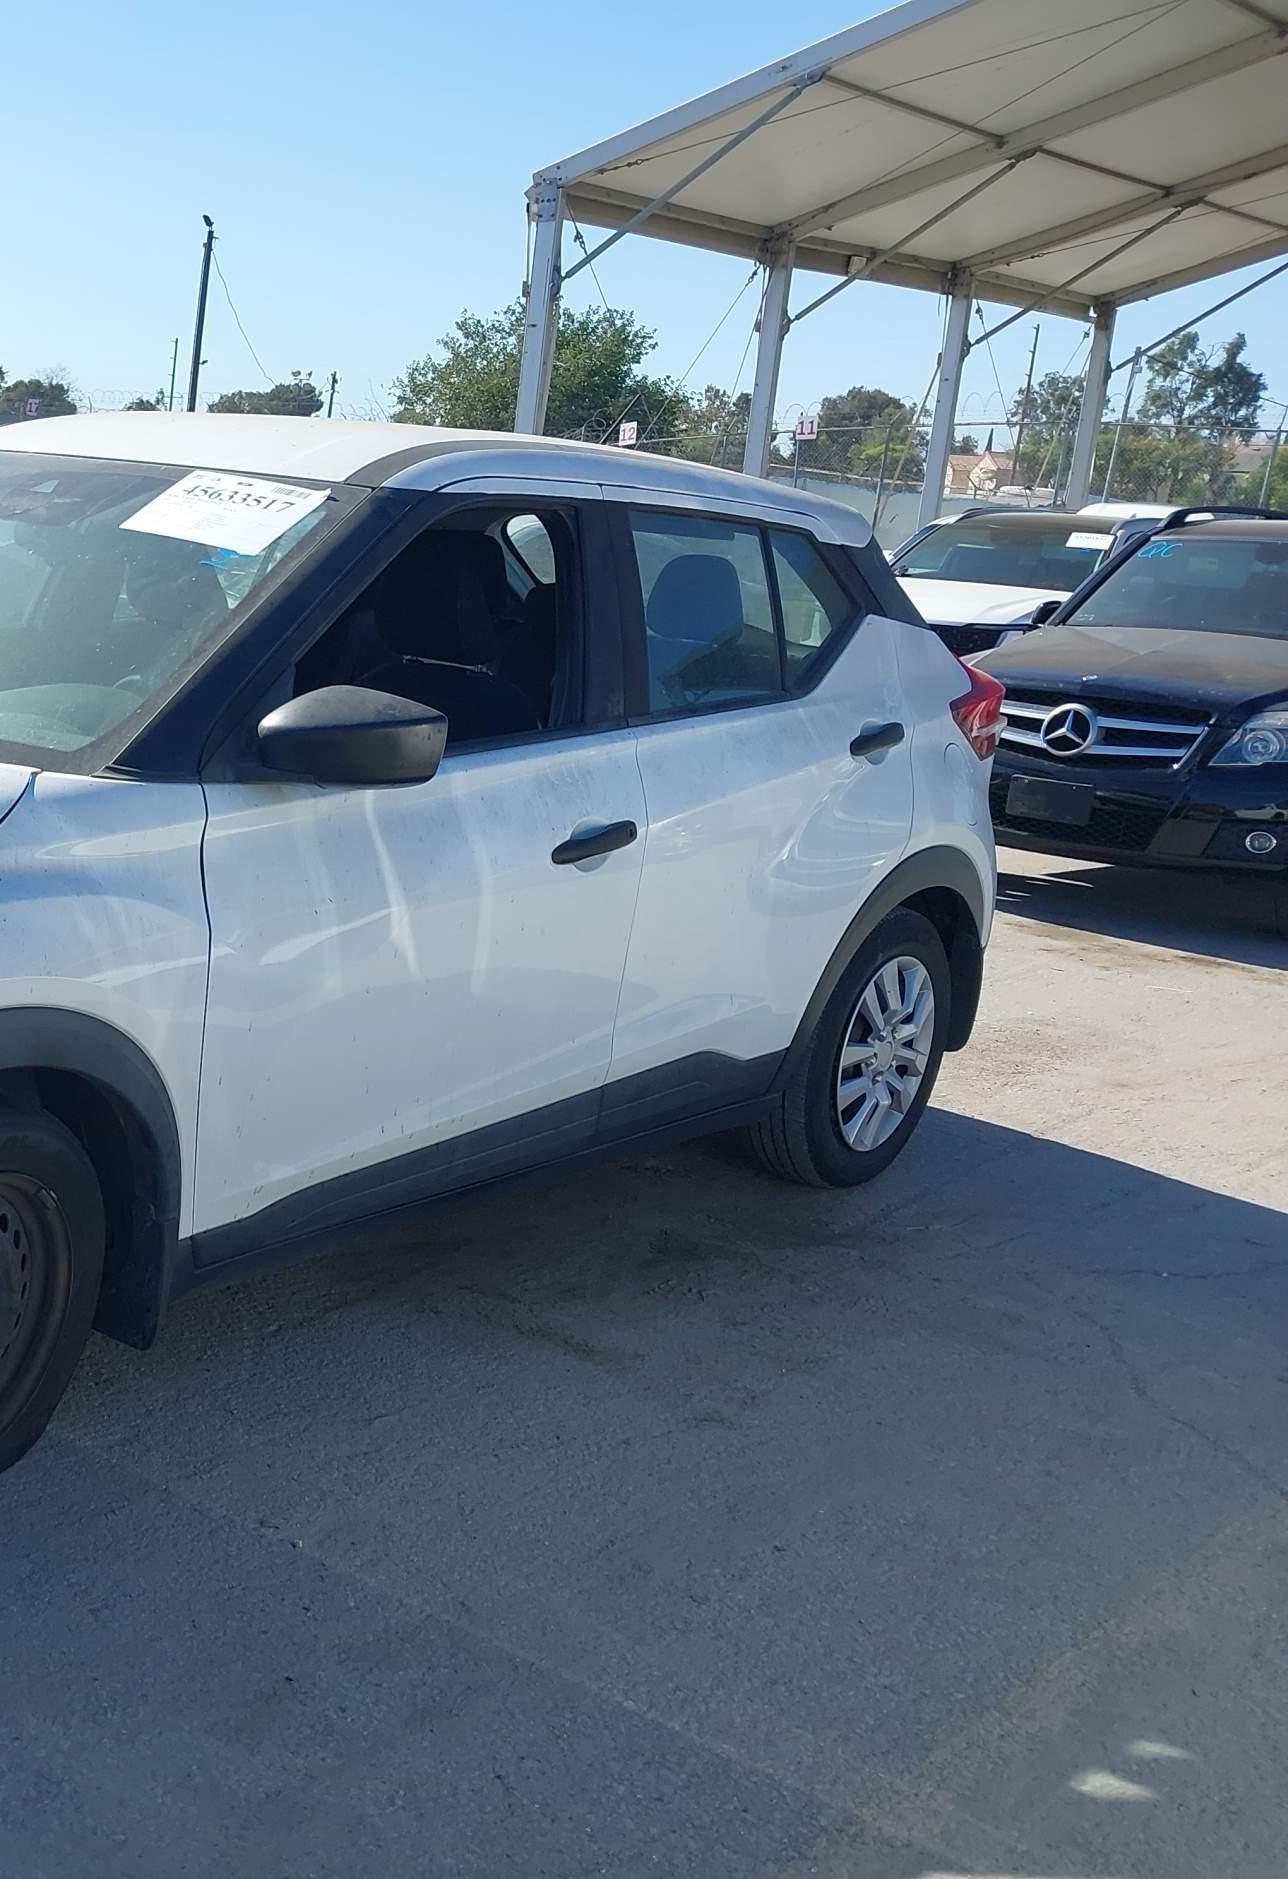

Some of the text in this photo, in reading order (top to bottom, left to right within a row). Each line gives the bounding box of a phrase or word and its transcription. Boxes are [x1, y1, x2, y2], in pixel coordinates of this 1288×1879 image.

[620, 426, 636, 442] 12
[796, 420, 816, 435] 11
[183, 484, 296, 513] 45633517
